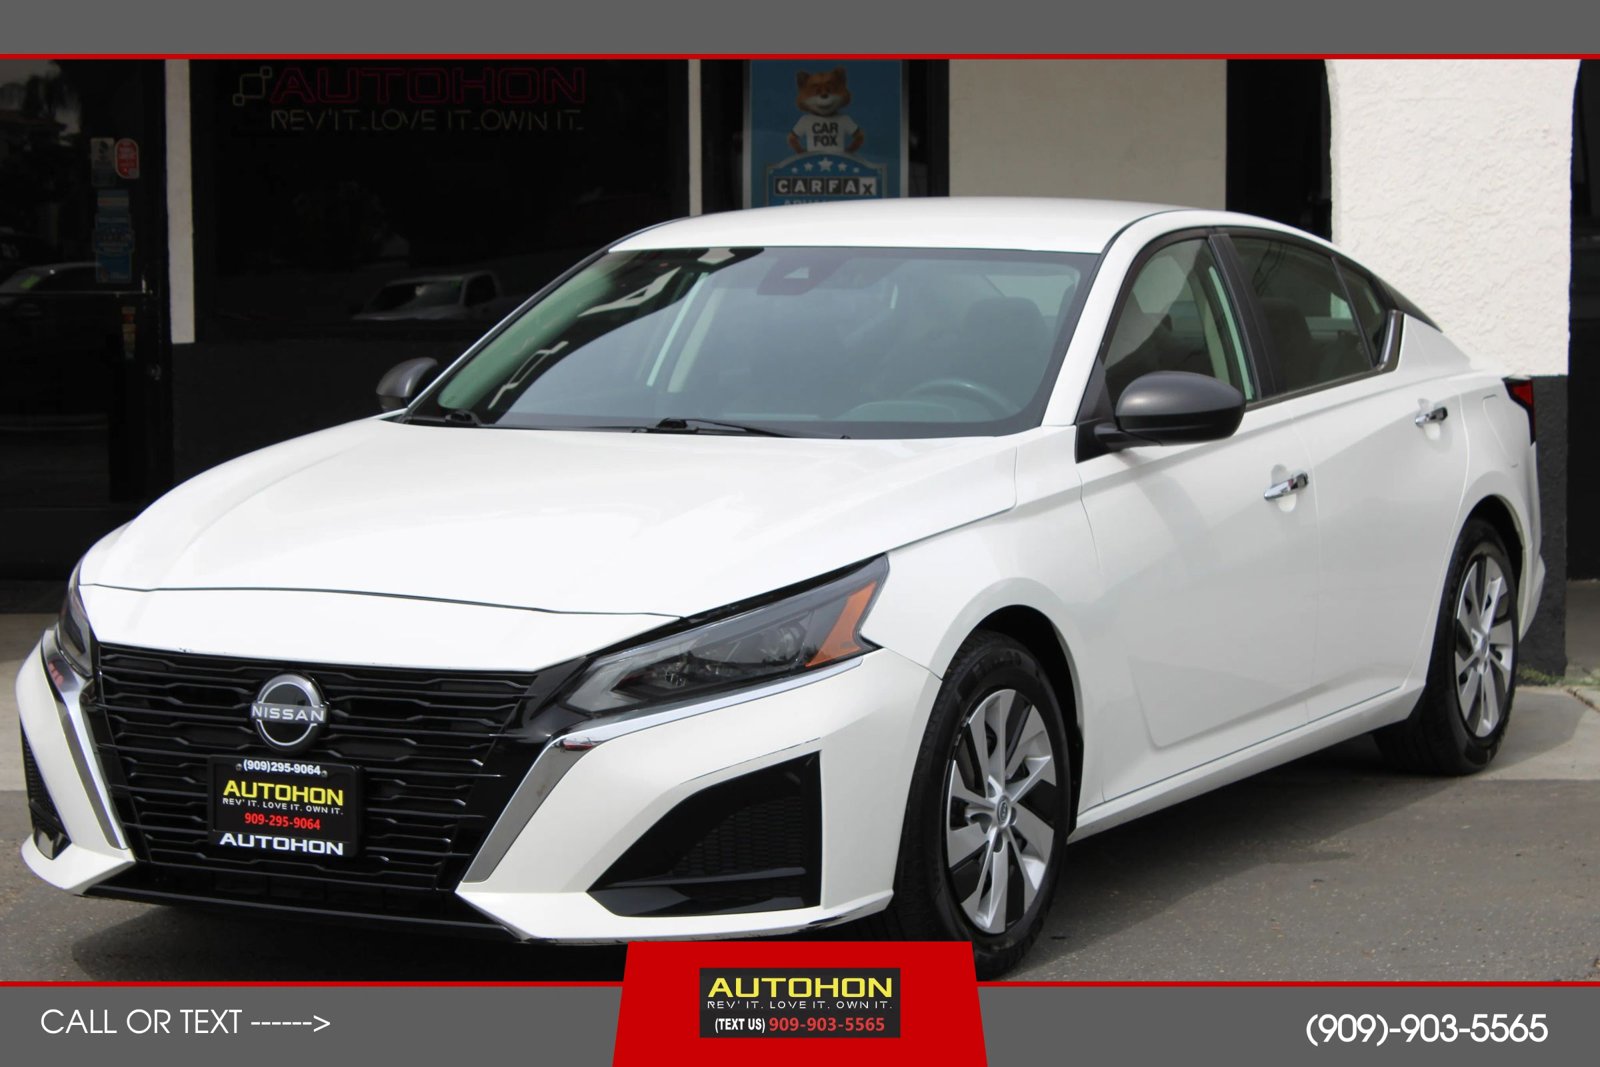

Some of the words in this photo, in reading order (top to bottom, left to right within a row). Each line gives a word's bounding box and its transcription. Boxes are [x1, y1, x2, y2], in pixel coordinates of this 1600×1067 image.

[269, 65, 588, 106] AUTOHON
[812, 122, 839, 134] CAR
[813, 135, 838, 147] FOX
[776, 179, 875, 195] CARFAX
[251, 705, 324, 722] NISSAN
[243, 759, 321, 776] (909)295-9064
[223, 780, 343, 806] AUTOHON
[263, 801, 287, 810] LOVE
[306, 805, 328, 814] OWN
[244, 812, 321, 830] 909-295-9064
[220, 833, 343, 856] AUTOHON
